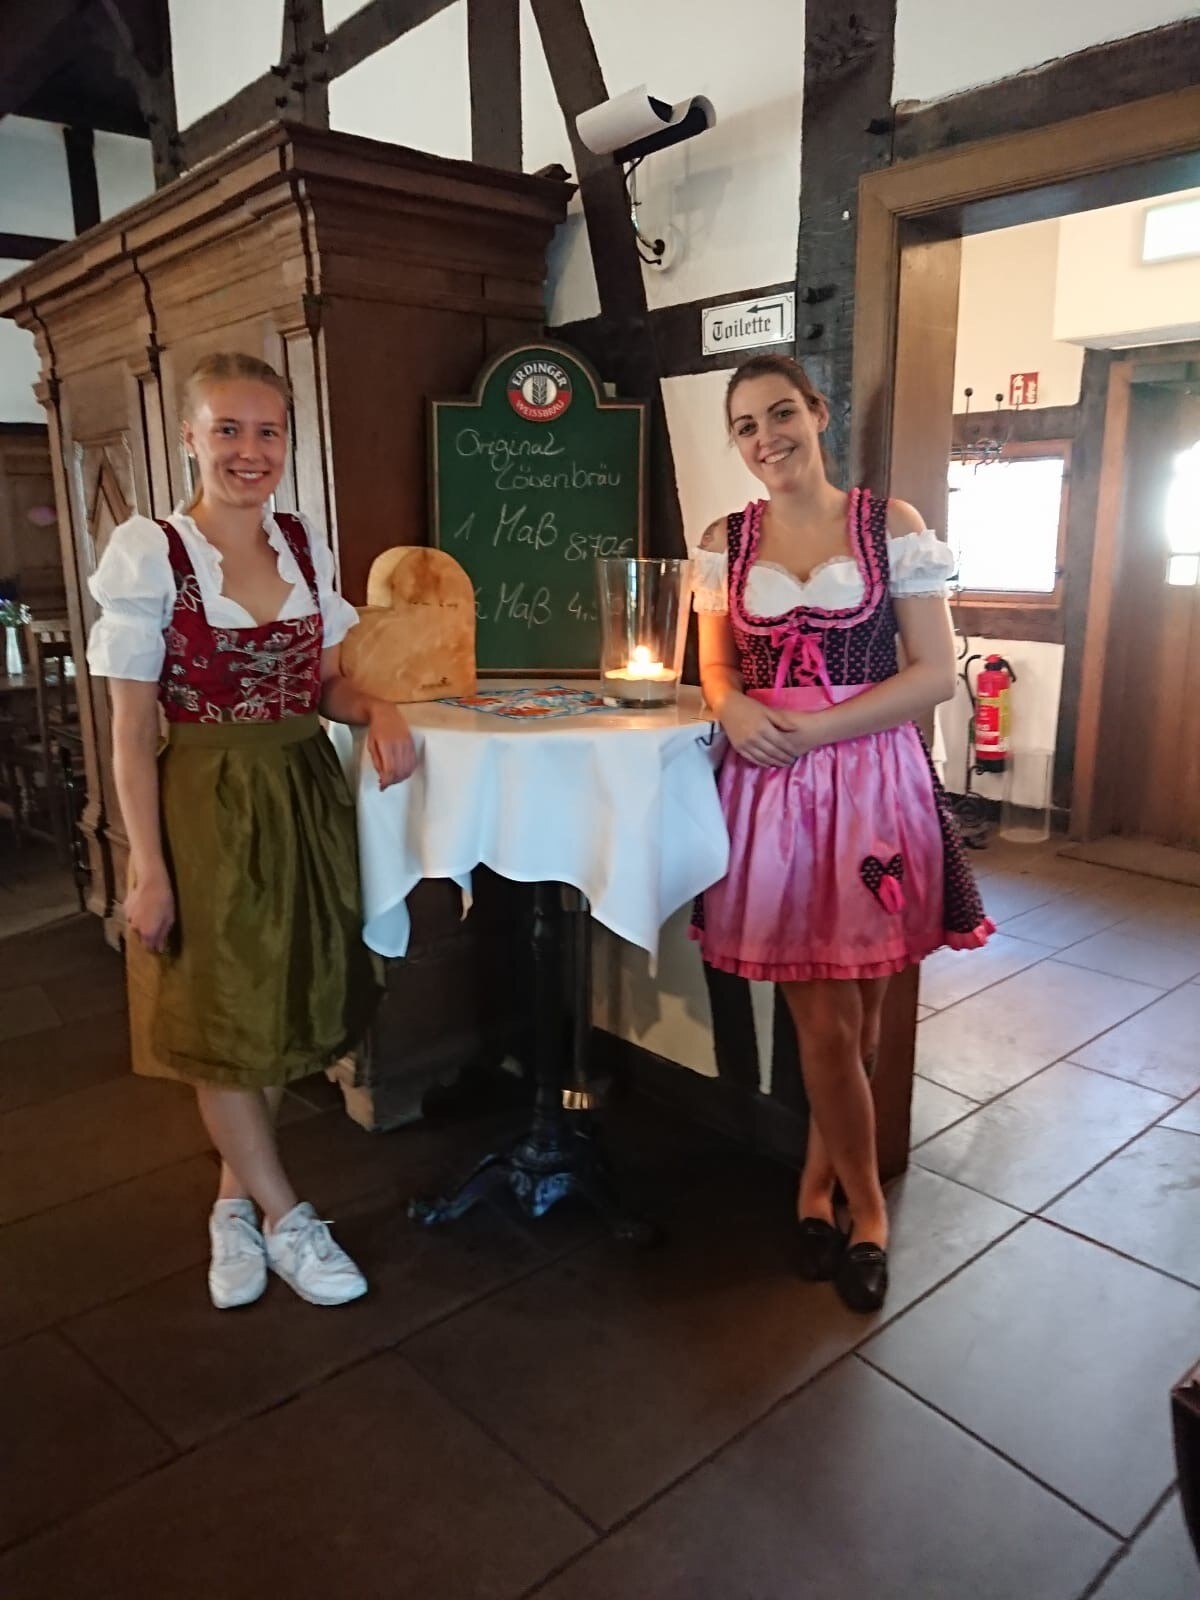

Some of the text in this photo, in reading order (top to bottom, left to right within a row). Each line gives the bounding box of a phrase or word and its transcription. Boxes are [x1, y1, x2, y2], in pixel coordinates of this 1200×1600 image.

[712, 316, 771, 341] Toilette
[511, 363, 568, 387] ERDINGER
[454, 512, 476, 541] 1
[493, 503, 558, 550] Maß
[494, 582, 551, 629] Maß
